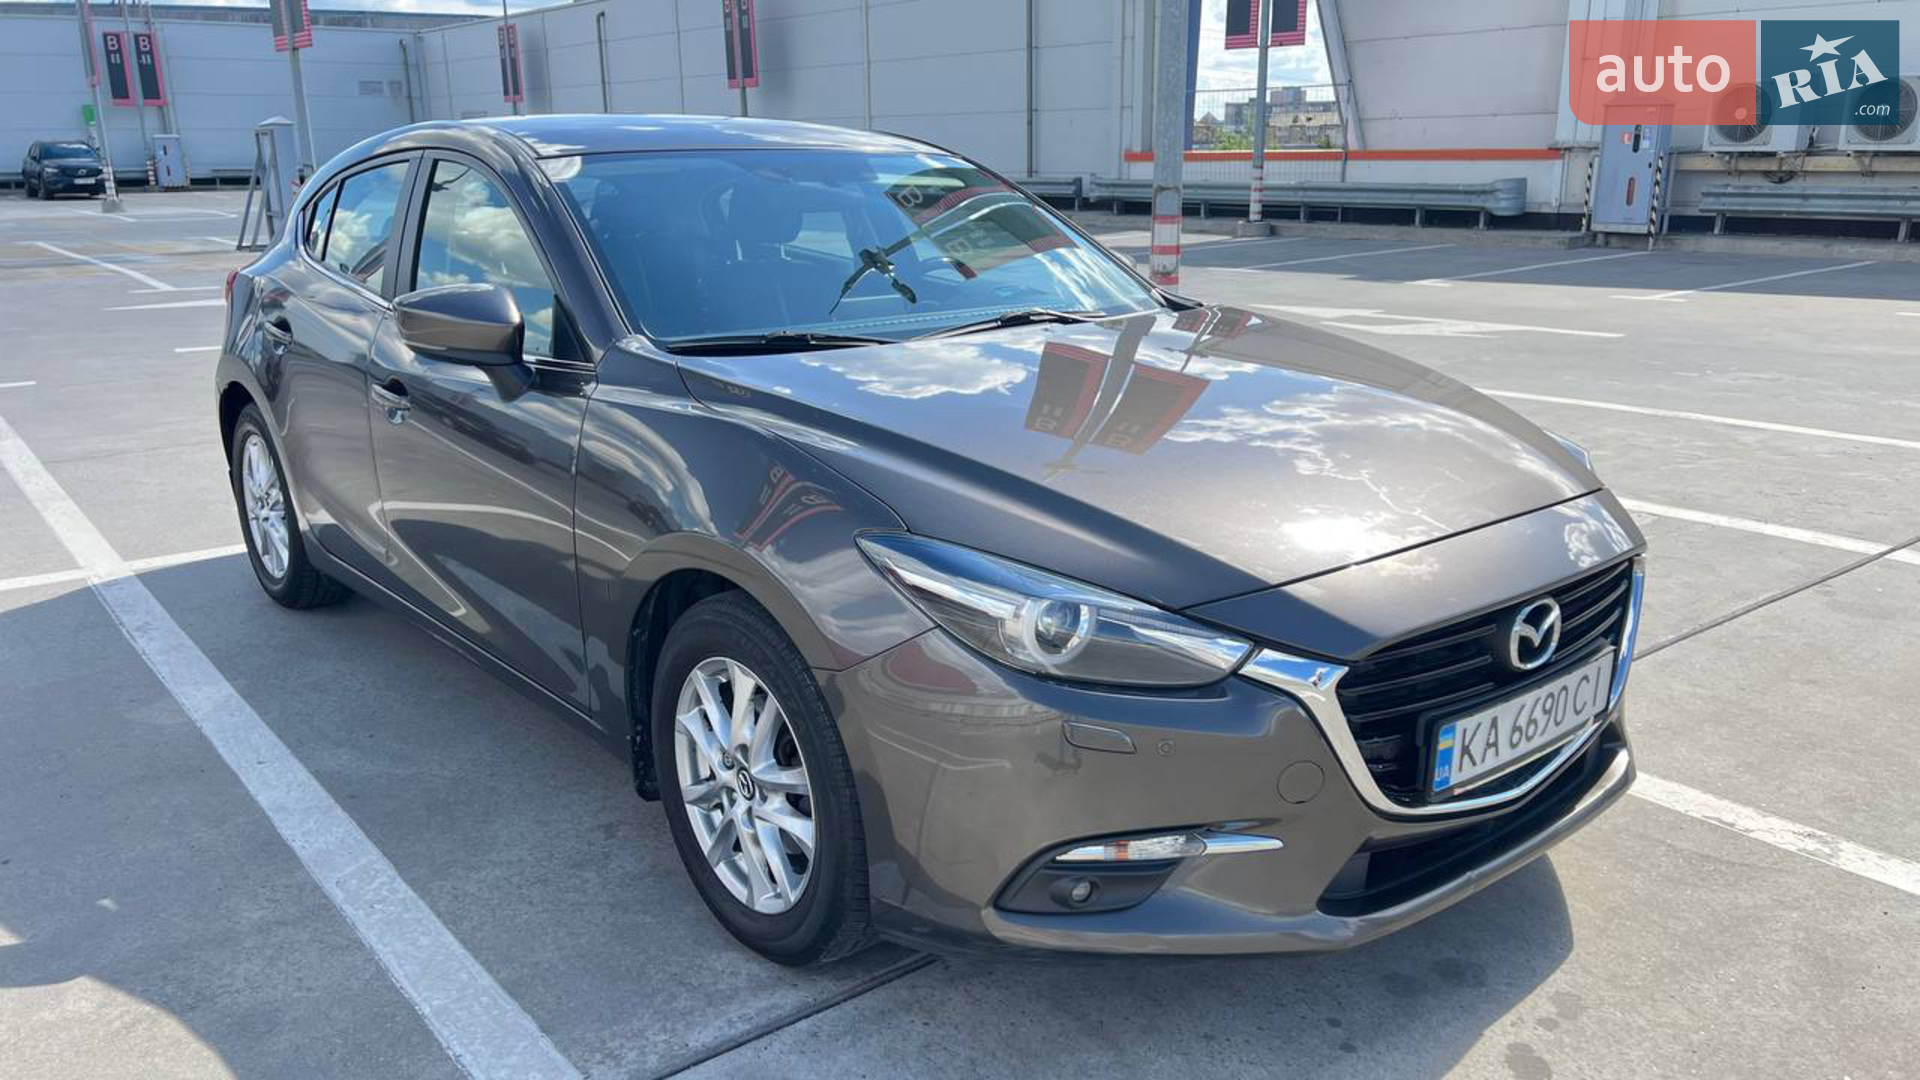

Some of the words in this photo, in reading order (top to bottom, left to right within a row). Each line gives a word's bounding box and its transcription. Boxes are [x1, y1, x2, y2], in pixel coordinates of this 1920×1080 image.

[107, 35, 118, 50] B
[139, 36, 150, 51] B
[1458, 714, 1500, 773] KA
[1509, 684, 1568, 750] 6690
[1572, 666, 1602, 716] CI
